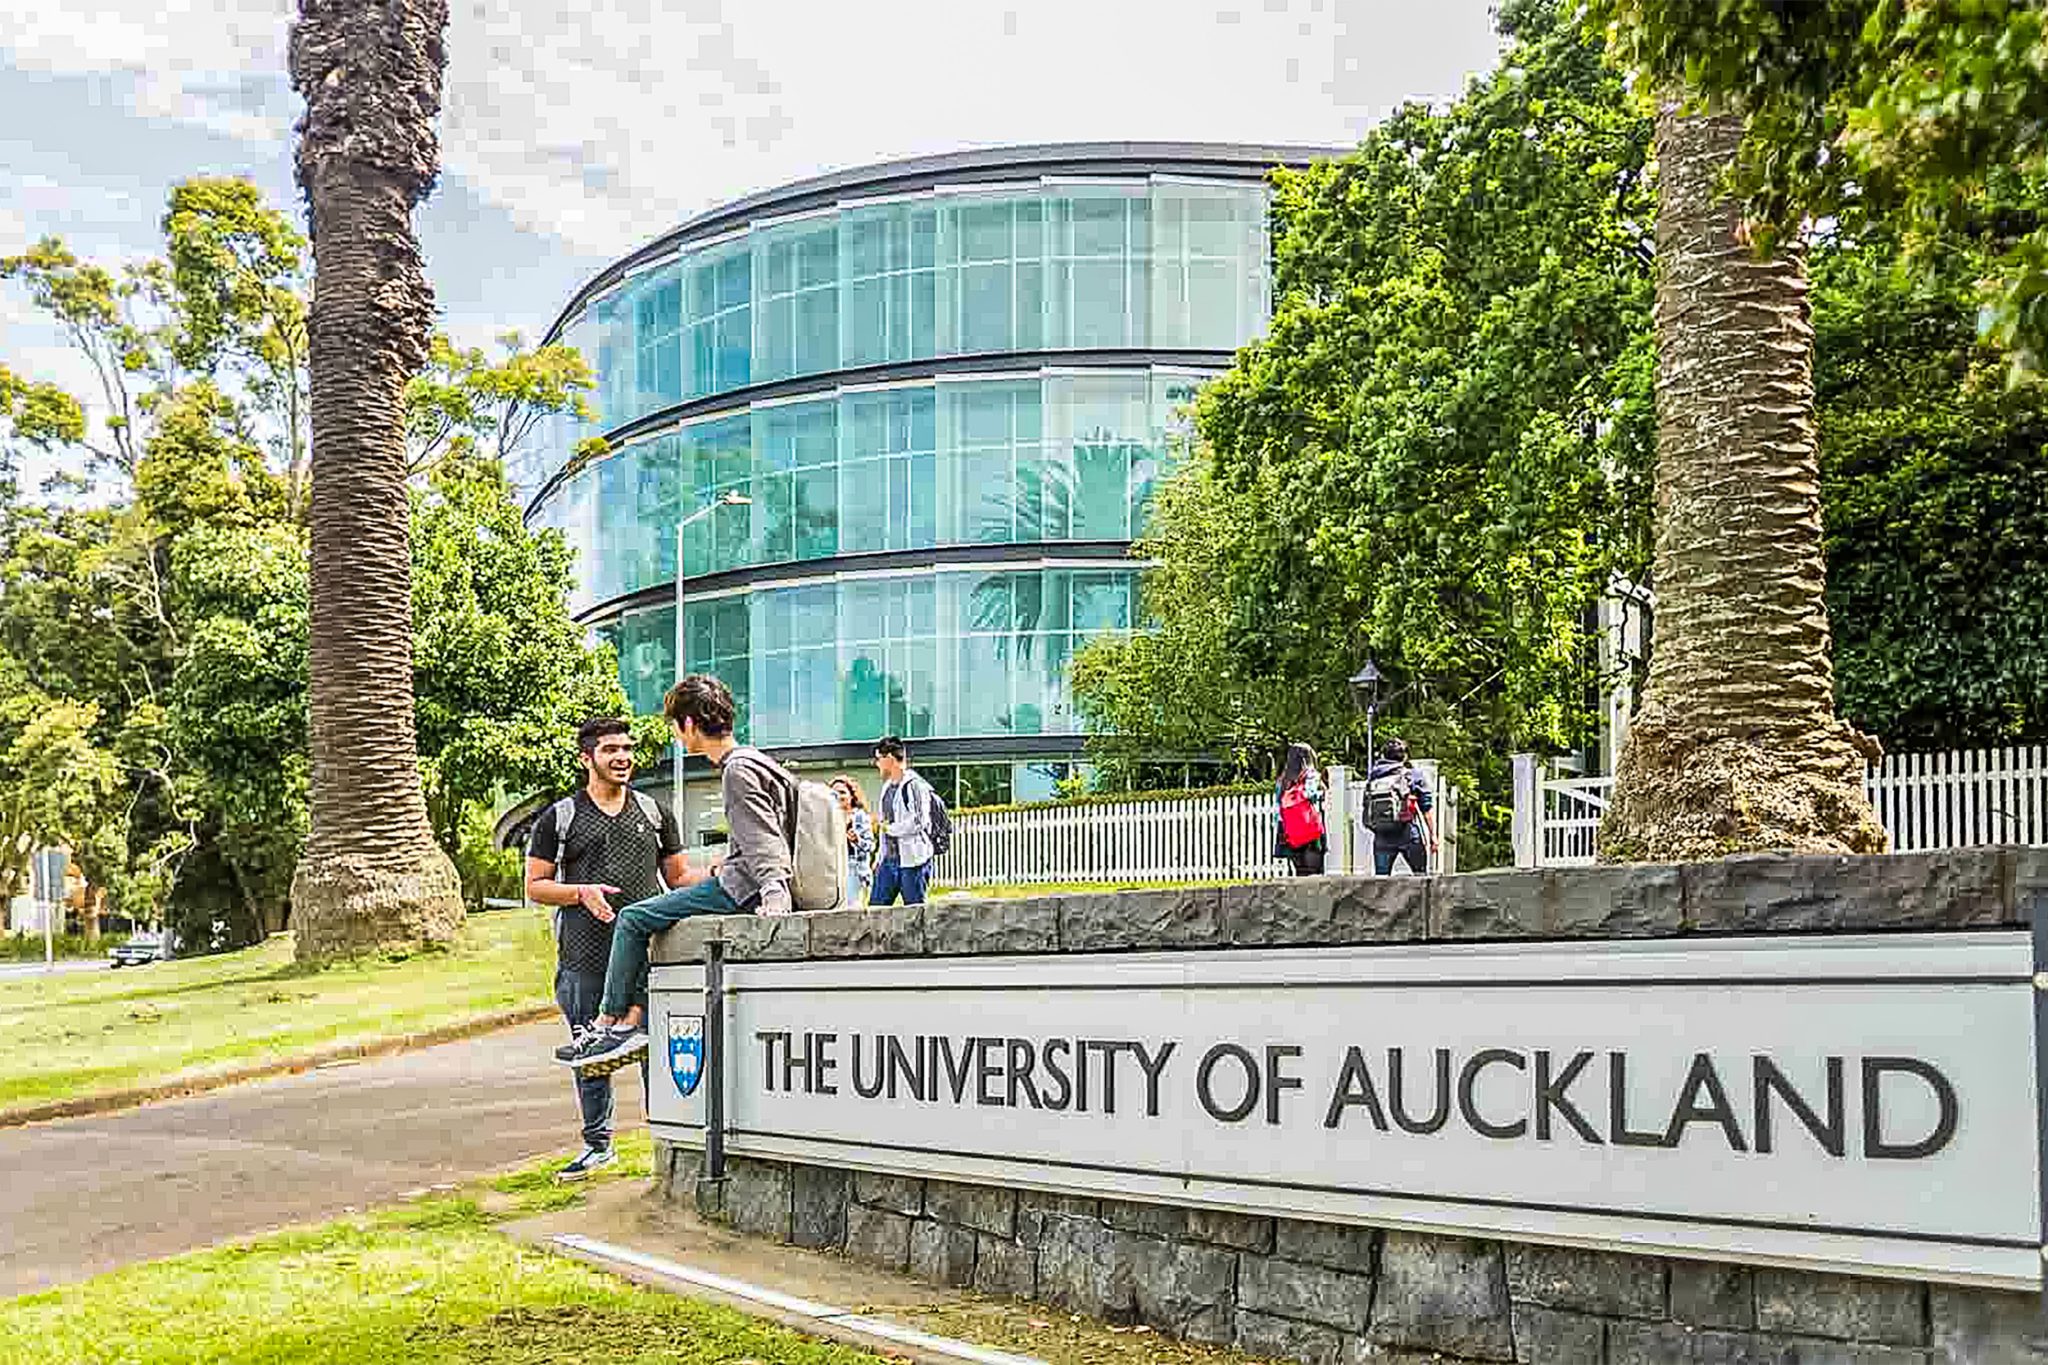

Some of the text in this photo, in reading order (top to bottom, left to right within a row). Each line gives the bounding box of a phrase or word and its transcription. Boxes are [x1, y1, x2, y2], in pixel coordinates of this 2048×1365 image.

[756, 1032, 1959, 1160] THE UNIVERSITY OF AUCKLAND
